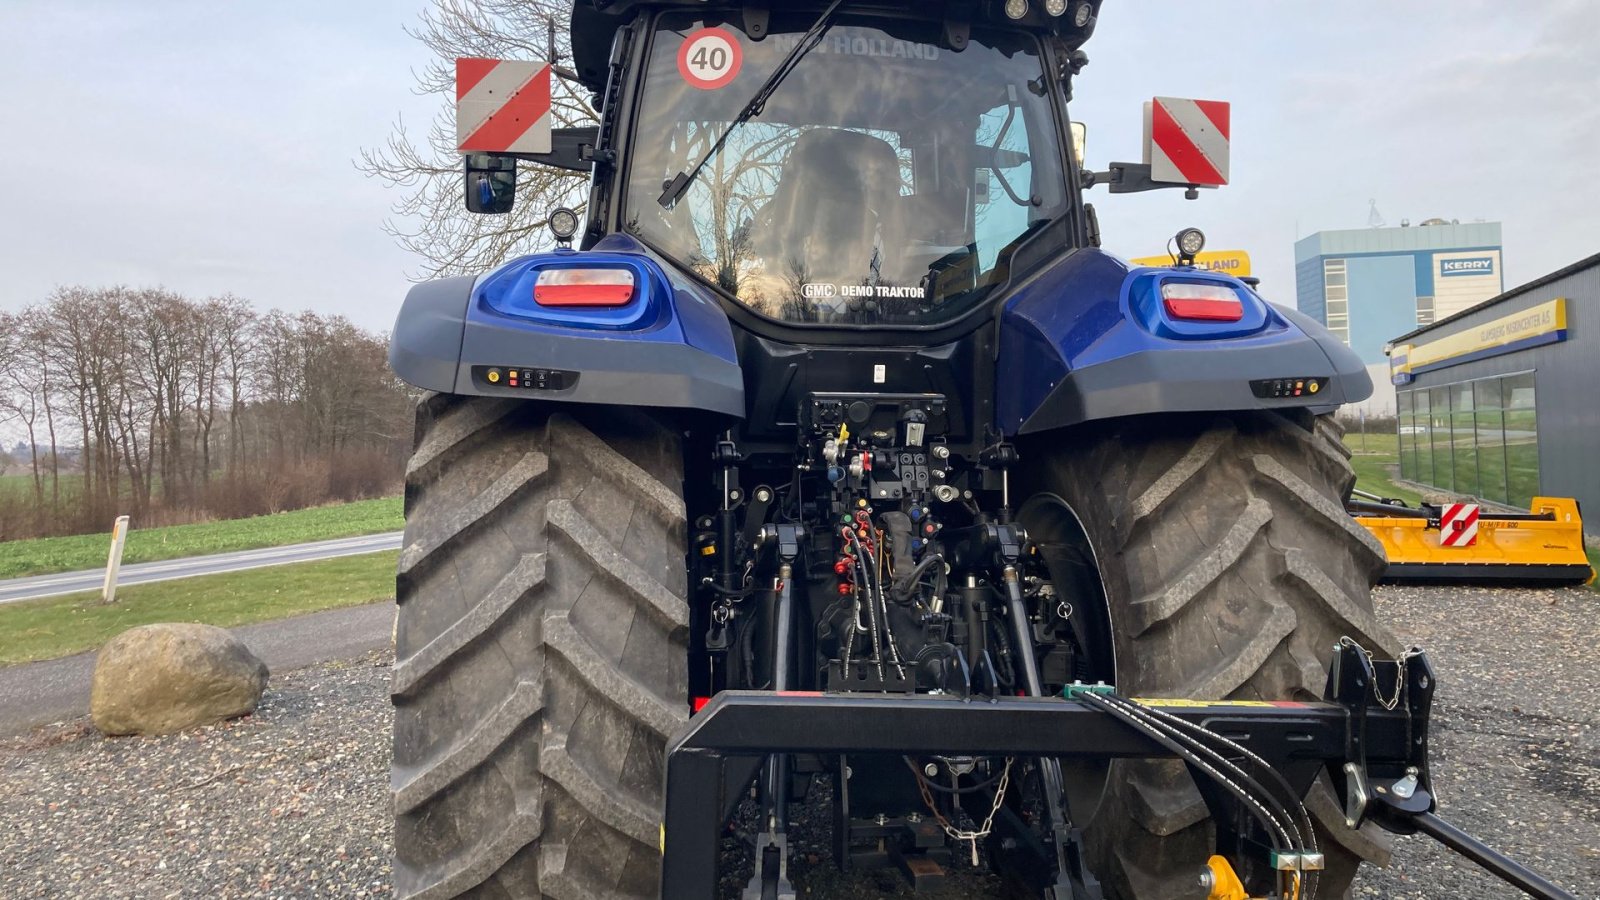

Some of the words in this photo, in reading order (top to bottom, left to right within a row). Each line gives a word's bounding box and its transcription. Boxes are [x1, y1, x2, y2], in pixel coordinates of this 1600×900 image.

[834, 37, 939, 61] HOLLAND
[690, 47, 727, 71] 40
[1444, 260, 1490, 270] KERRY
[805, 285, 833, 297] GMC
[841, 286, 873, 297] DEMO
[875, 286, 925, 298] TRAKTOR
